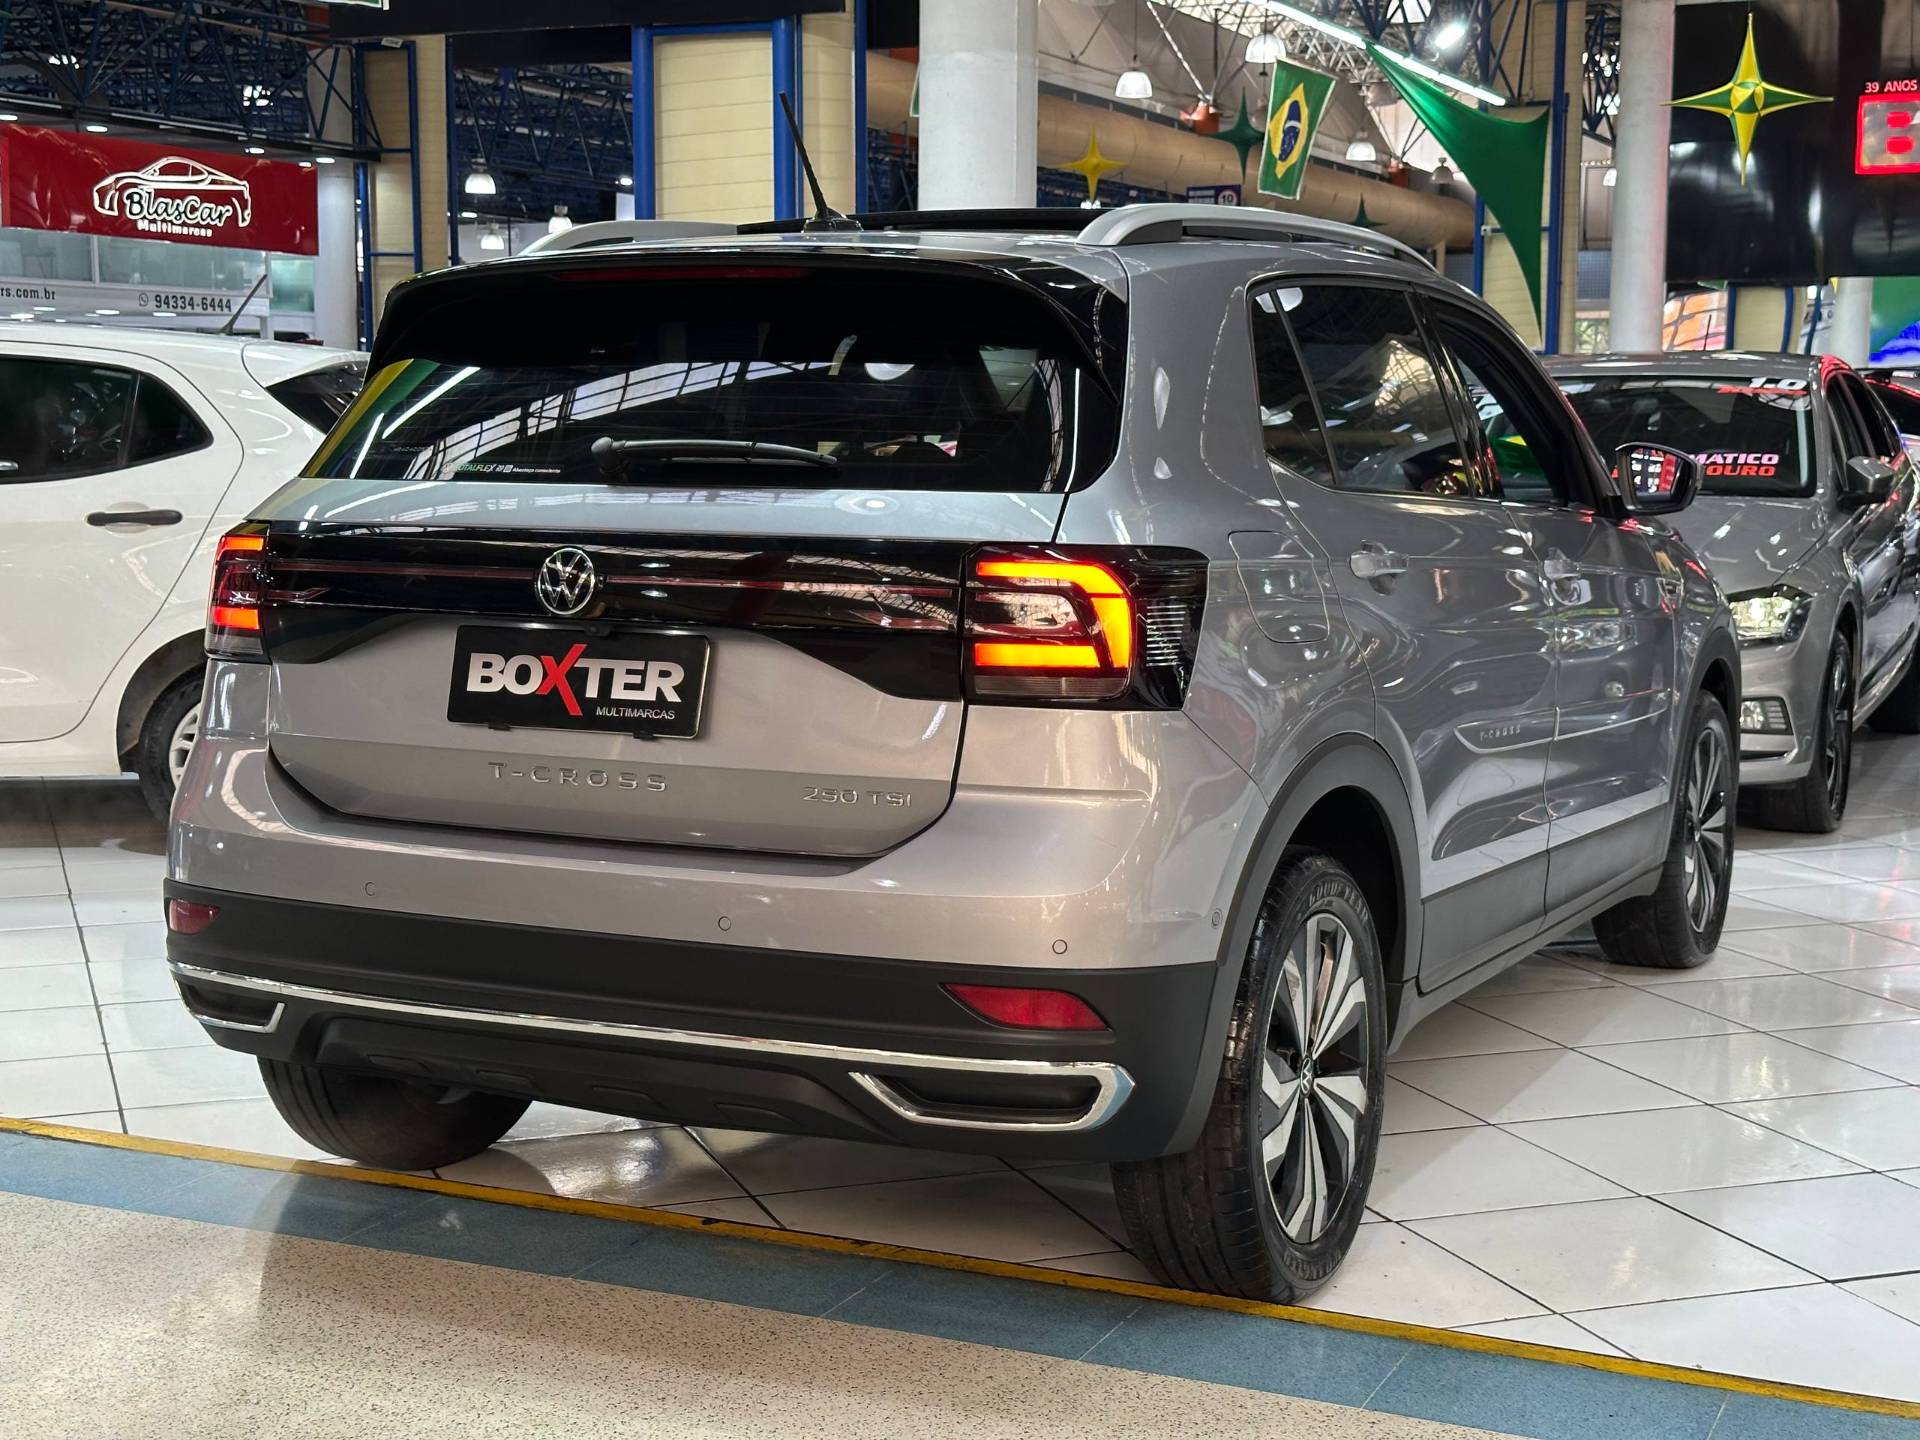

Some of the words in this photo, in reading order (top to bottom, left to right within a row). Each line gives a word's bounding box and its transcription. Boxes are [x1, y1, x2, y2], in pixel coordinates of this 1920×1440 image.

[1864, 82, 1880, 93] 39
[1883, 80, 1918, 92] ANOS
[124, 189, 232, 226] BlasCar
[137, 219, 213, 237] Multimarcas
[154, 294, 232, 313] 94334-6444
[466, 643, 685, 717] BOXTER
[596, 706, 675, 720] MULTIMARCAS
[488, 762, 667, 792] T-CROSS
[802, 786, 859, 805] 250
[866, 791, 911, 808] TSI
